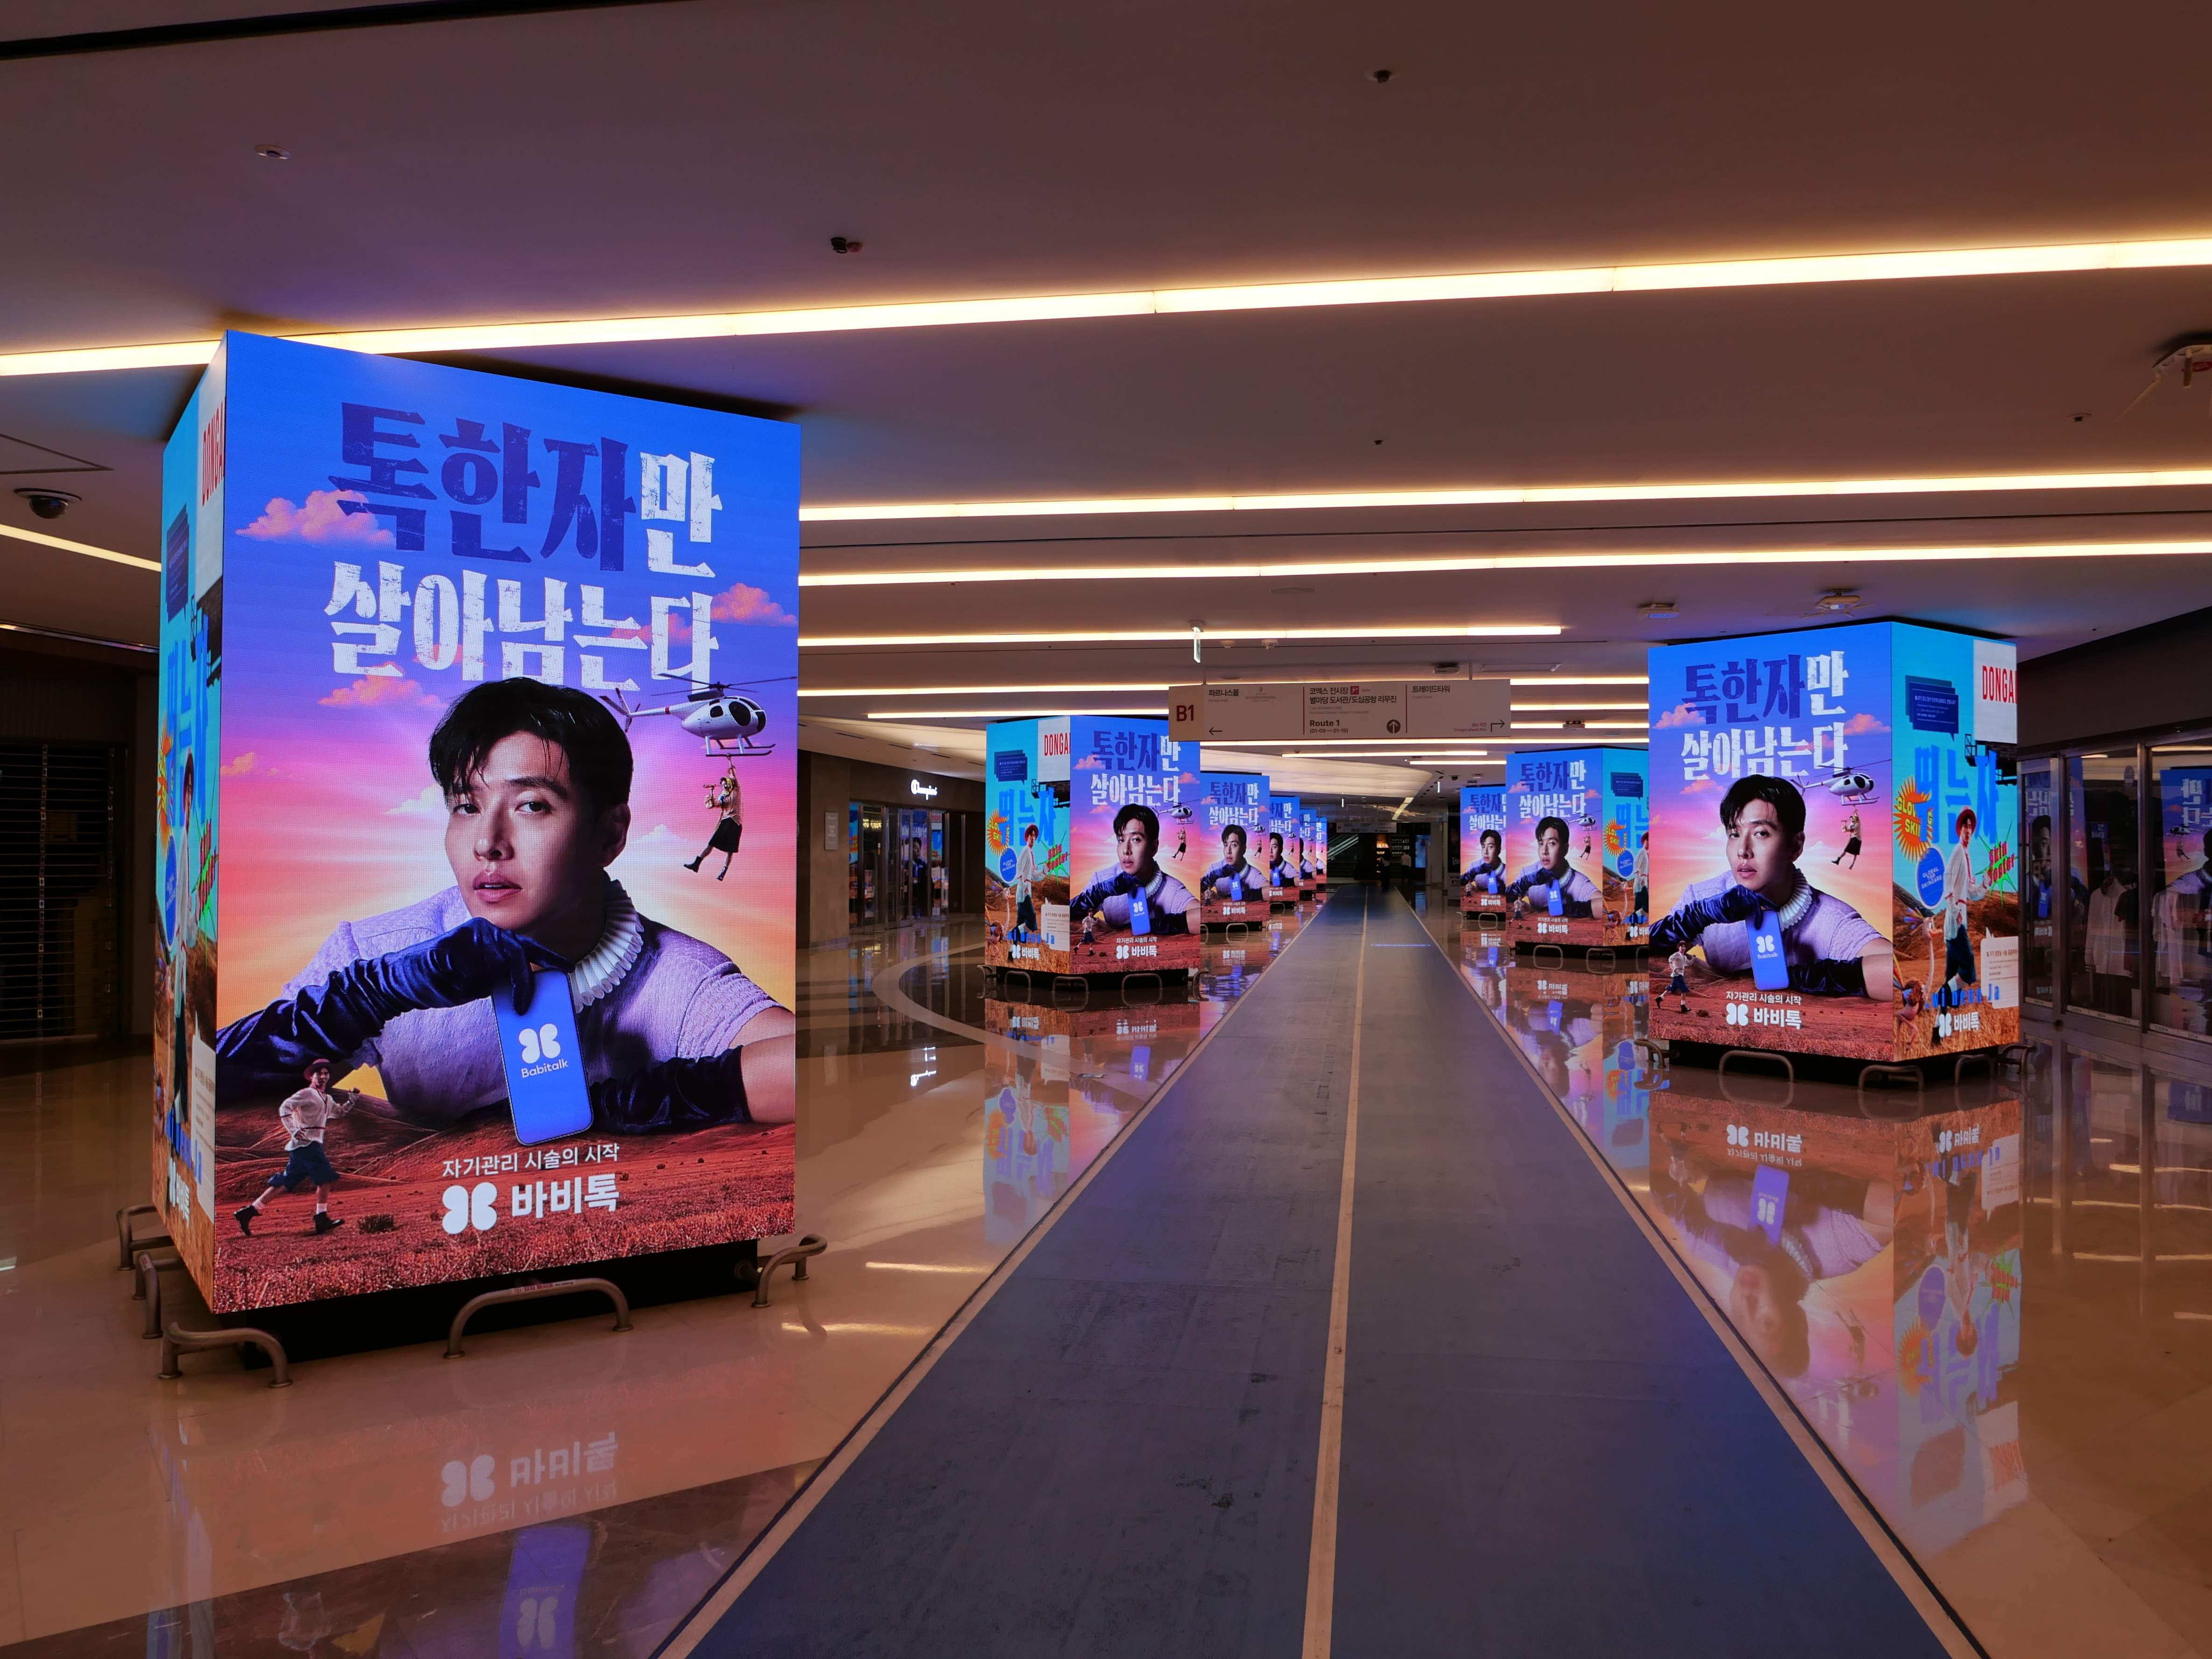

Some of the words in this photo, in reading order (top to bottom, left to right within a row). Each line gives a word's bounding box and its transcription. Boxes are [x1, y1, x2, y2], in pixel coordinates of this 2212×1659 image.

[328, 402, 723, 578] 톡한자만
[324, 561, 719, 694] 살아남는다
[1681, 650, 1849, 724] 톡한자만
[1177, 704, 1194, 722] B1
[1091, 730, 1181, 772] 톡한자만
[1681, 722, 1848, 781] 살아남는다
[1520, 760, 1587, 792] 톡한자만
[1091, 773, 1181, 807] 살아남는다
[1210, 782, 1259, 805] 톡한자만
[1209, 806, 1259, 825] 살아남는다
[1519, 793, 1586, 818] 살아남는다
[1548, 924, 1568, 934] 바비톡
[1022, 947, 1040, 960] 바비톡
[1132, 945, 1157, 957] 바비톡
[1726, 991, 1757, 1002] 자기관리
[1759, 993, 1782, 1004] 시술의
[1786, 996, 1802, 1006] 시작
[1753, 1007, 1802, 1030] 바비톡
[1954, 1012, 1979, 1032] 바비톡
[521, 1058, 568, 1078] Babitalk
[442, 1153, 518, 1178] 자기관리
[525, 1146, 578, 1170] 시술의
[586, 1143, 620, 1164] 시작
[511, 1173, 620, 1219] 바비톡
